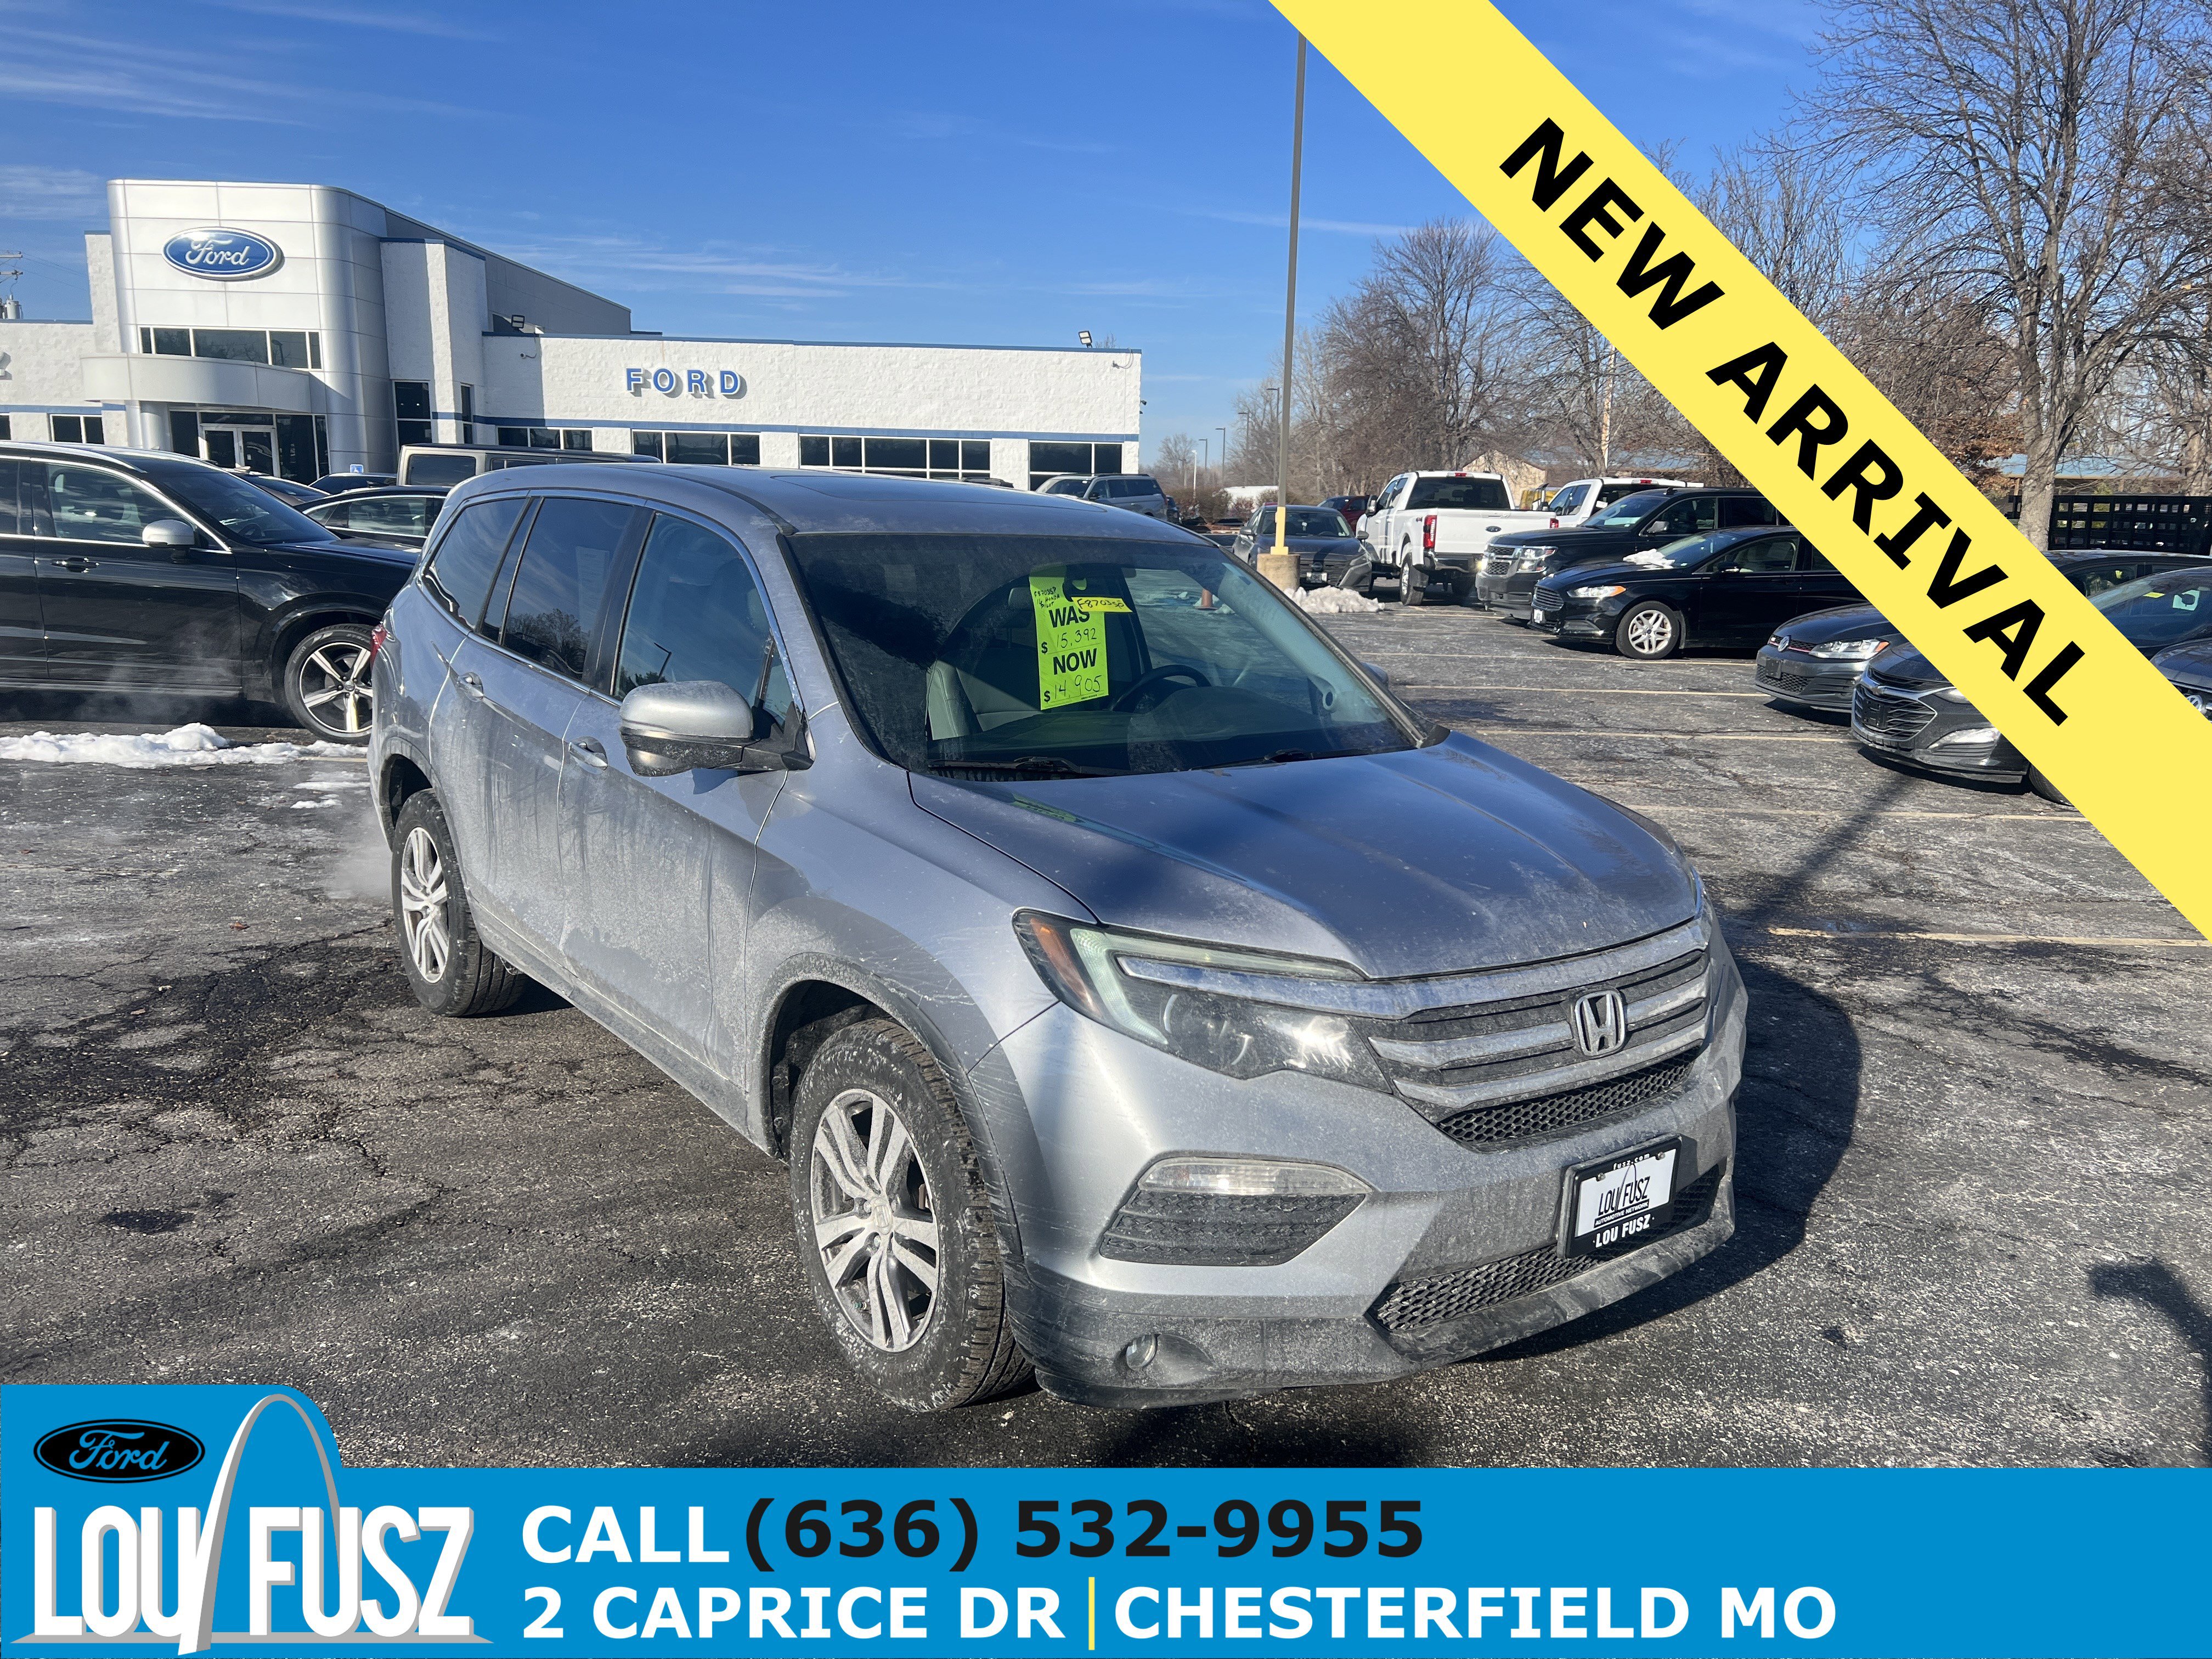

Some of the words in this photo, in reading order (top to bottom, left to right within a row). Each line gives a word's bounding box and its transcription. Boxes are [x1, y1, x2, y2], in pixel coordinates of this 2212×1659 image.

[185, 239, 250, 266] Ford
[626, 367, 741, 395] FORD
[1048, 606, 1090, 628] WAS
[1053, 648, 1097, 675] NOW
[1613, 1153, 1650, 1170] fusz.com
[1598, 1187, 1620, 1216] LOU
[1622, 1176, 1651, 1206] FUSZ
[1594, 1210, 1625, 1226] AUTOMOTIVE
[1625, 1202, 1649, 1214] NETWORK
[1595, 1226, 1620, 1248] LOU
[1621, 1214, 1651, 1238] FUSZ
